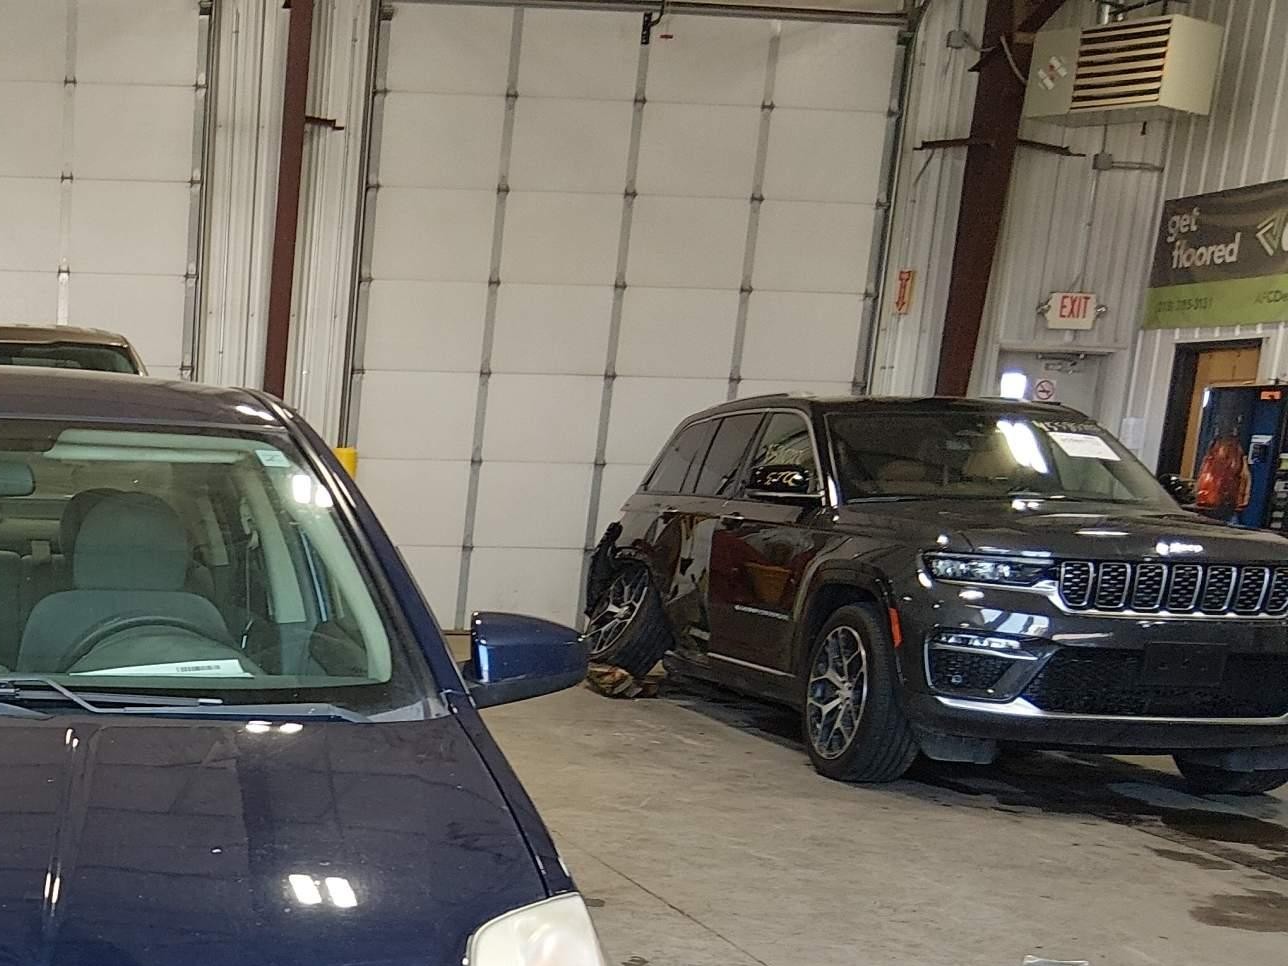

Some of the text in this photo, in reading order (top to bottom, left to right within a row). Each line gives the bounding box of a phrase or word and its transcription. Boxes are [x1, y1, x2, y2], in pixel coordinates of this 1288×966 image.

[1166, 206, 1201, 243] get
[1172, 231, 1241, 269] floored
[1059, 295, 1091, 319] EXIT
